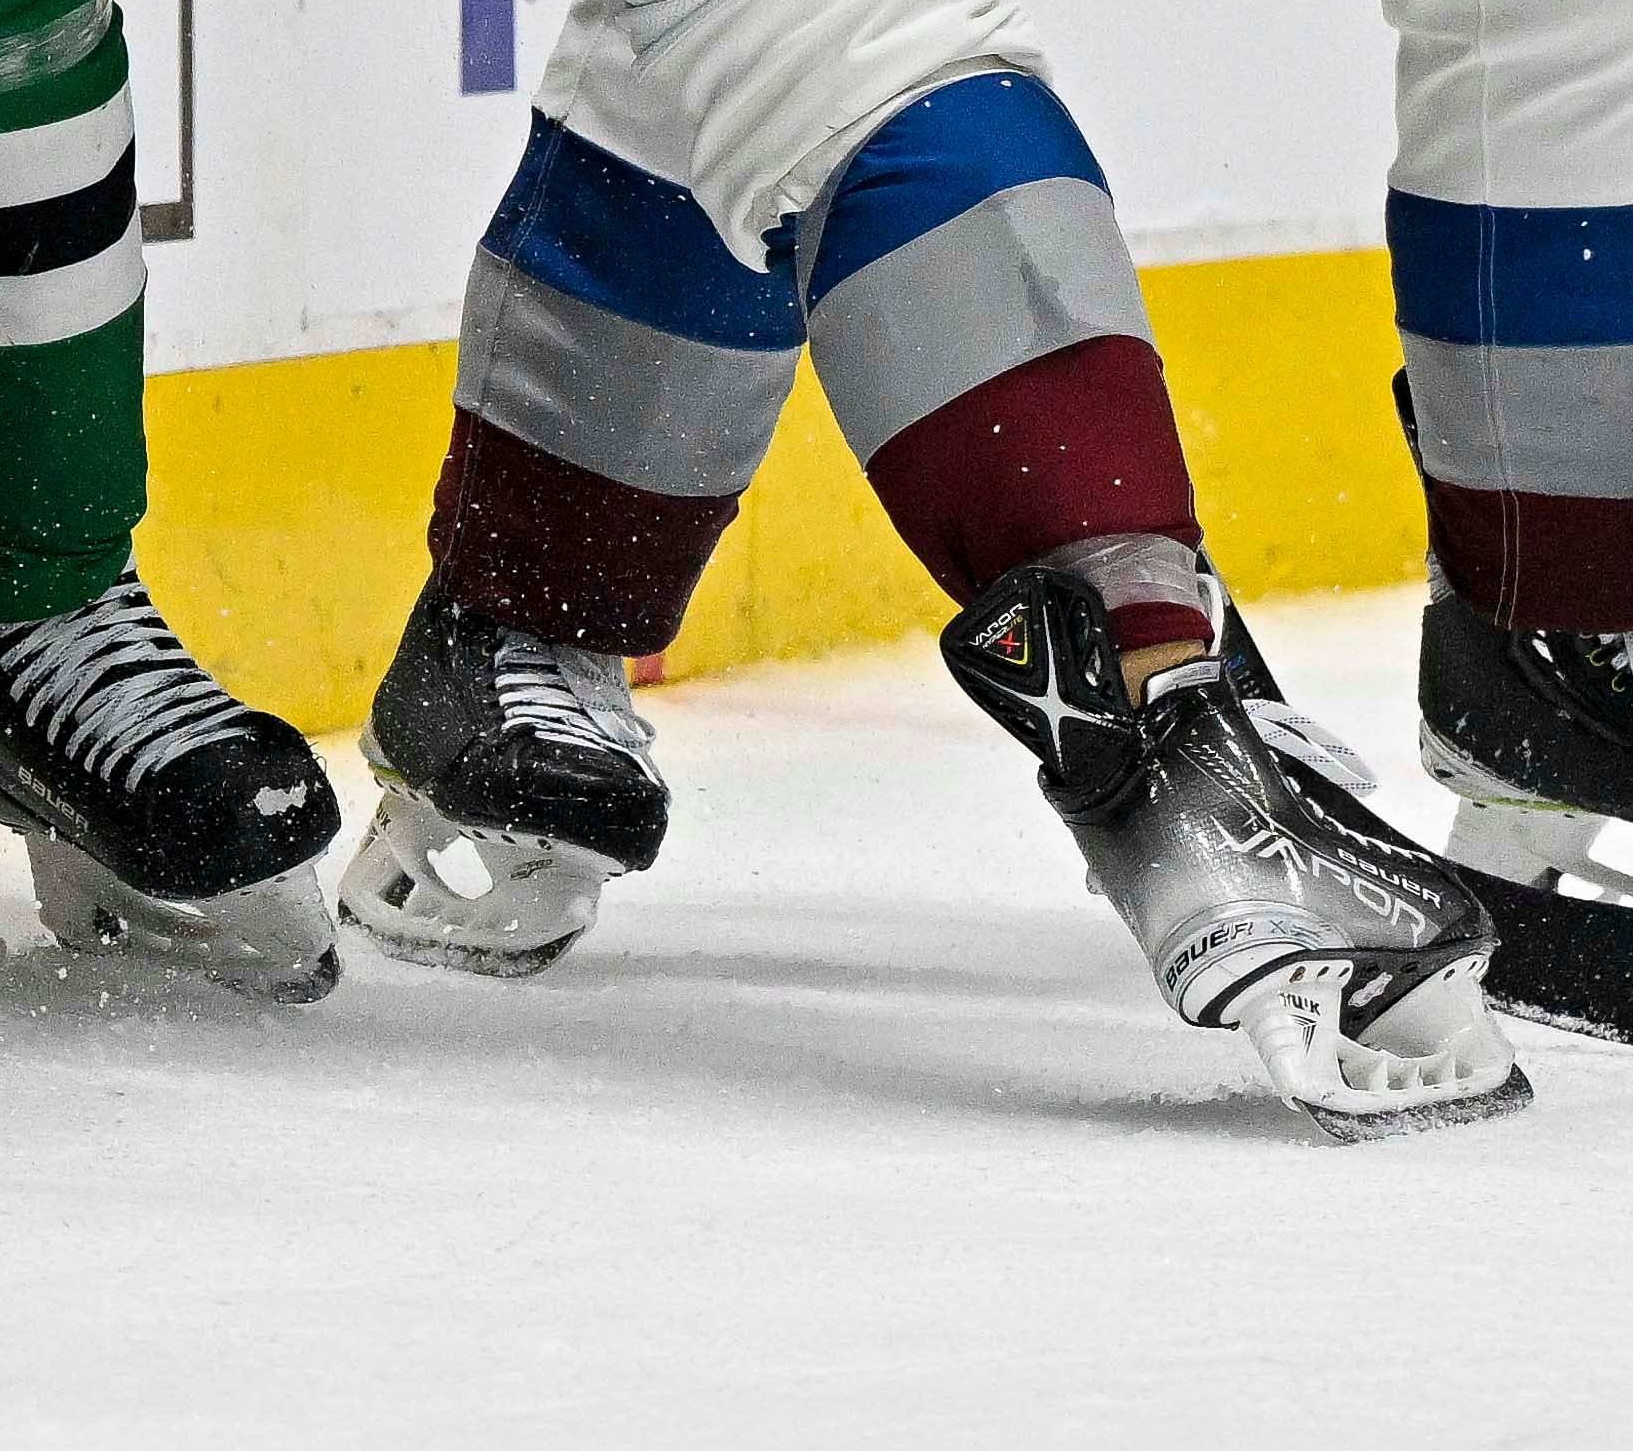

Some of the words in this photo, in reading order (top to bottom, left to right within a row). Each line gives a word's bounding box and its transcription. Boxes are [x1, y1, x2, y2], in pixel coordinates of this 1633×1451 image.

[969, 601, 1030, 650] VAPOR
[1210, 811, 1447, 948] VAPOR
[1337, 846, 1442, 911] BAUER
